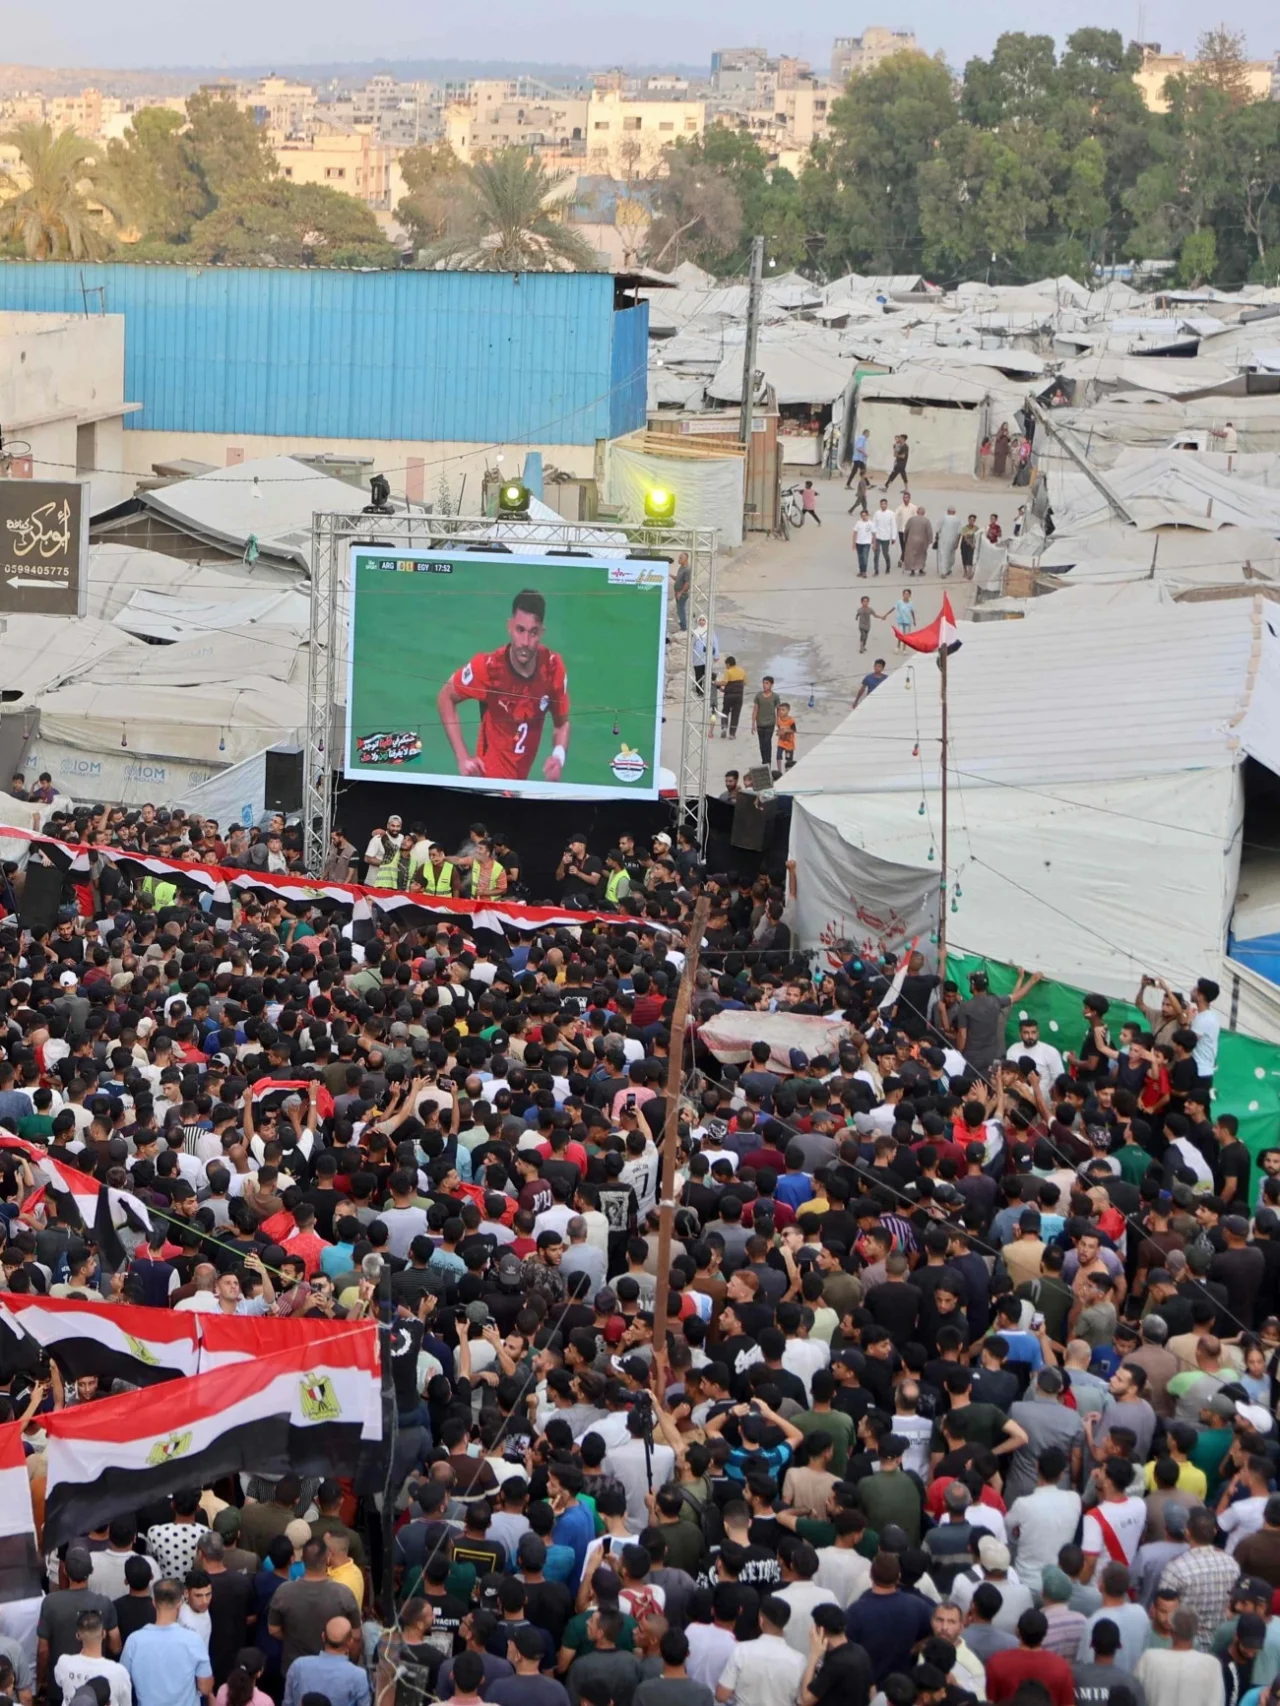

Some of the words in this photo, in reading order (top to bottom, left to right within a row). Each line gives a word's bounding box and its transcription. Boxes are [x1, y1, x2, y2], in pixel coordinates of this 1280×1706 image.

[4, 564, 70, 576] 0599405775
[381, 561, 395, 570] ARG
[417, 563, 430, 571] EGY
[434, 564, 451, 573] 17:52
[514, 722, 528, 754] 2
[74, 759, 101, 773] IOM
[138, 766, 165, 780] IOM
[634, 1172, 649, 1199] 7
